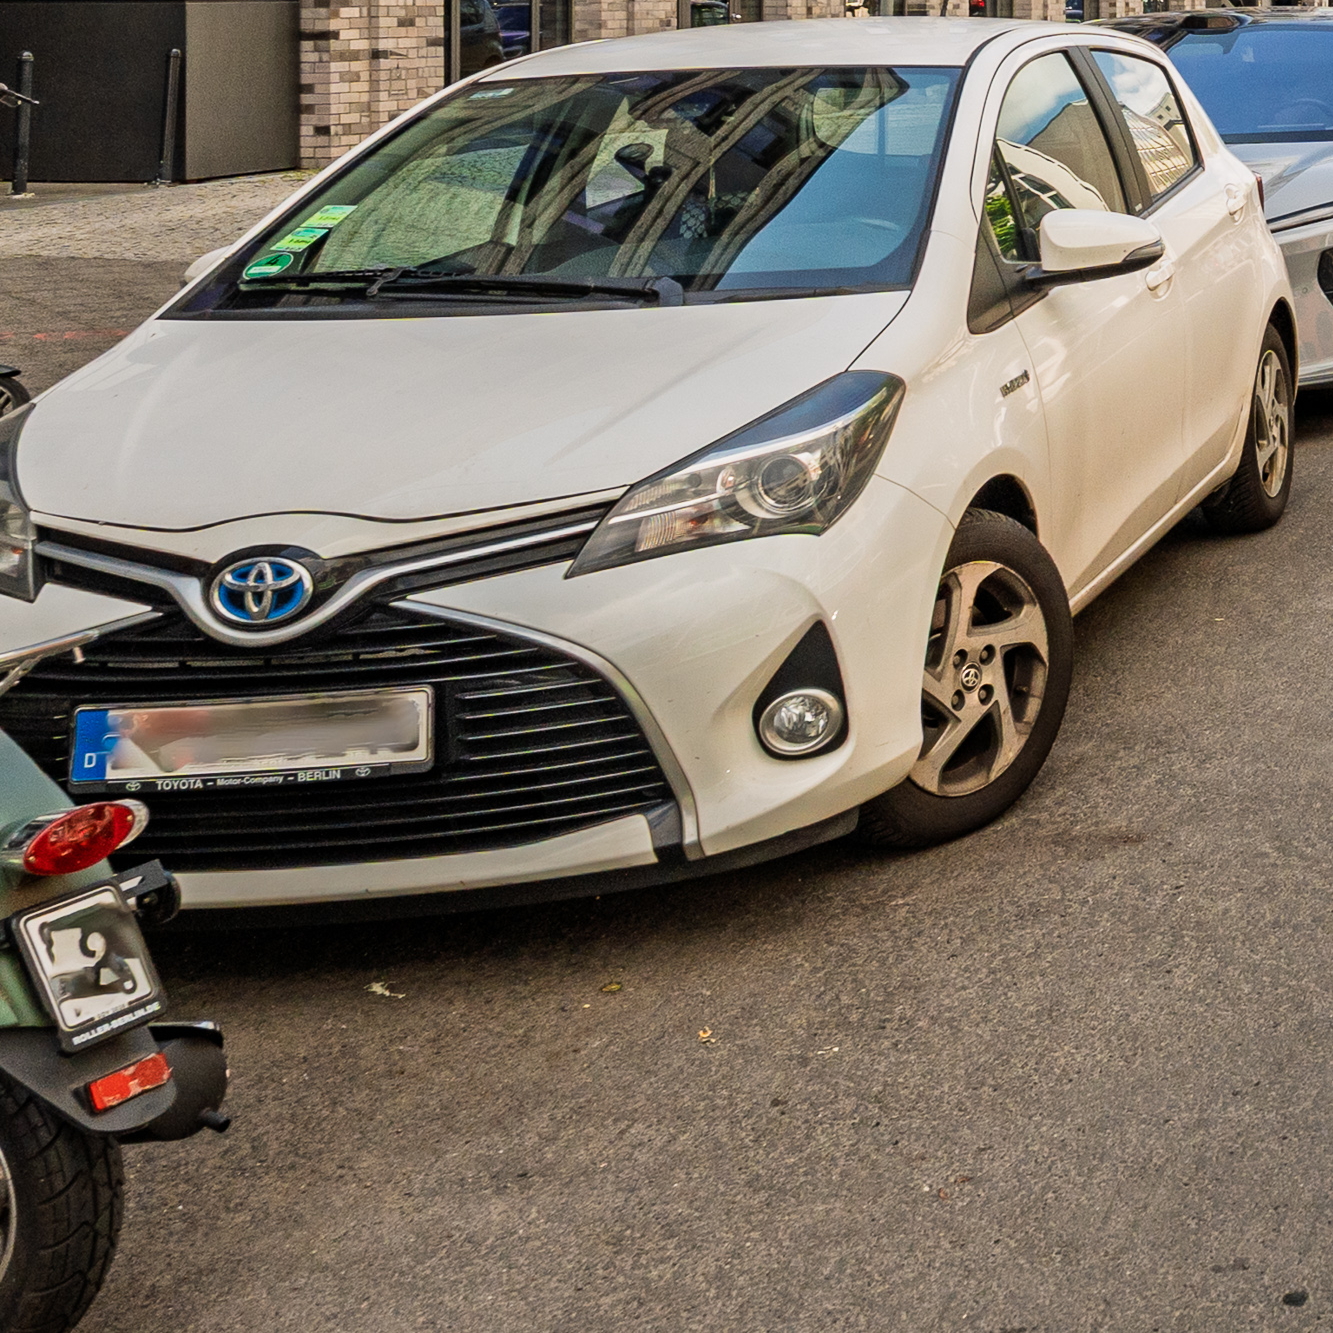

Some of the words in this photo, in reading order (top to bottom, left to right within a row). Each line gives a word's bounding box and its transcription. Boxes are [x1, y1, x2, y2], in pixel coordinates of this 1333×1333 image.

[83, 752, 97, 769] D
[155, 779, 203, 791] TOYOTA
[216, 775, 285, 787] Motor-Company
[297, 769, 341, 782] BERLIN
